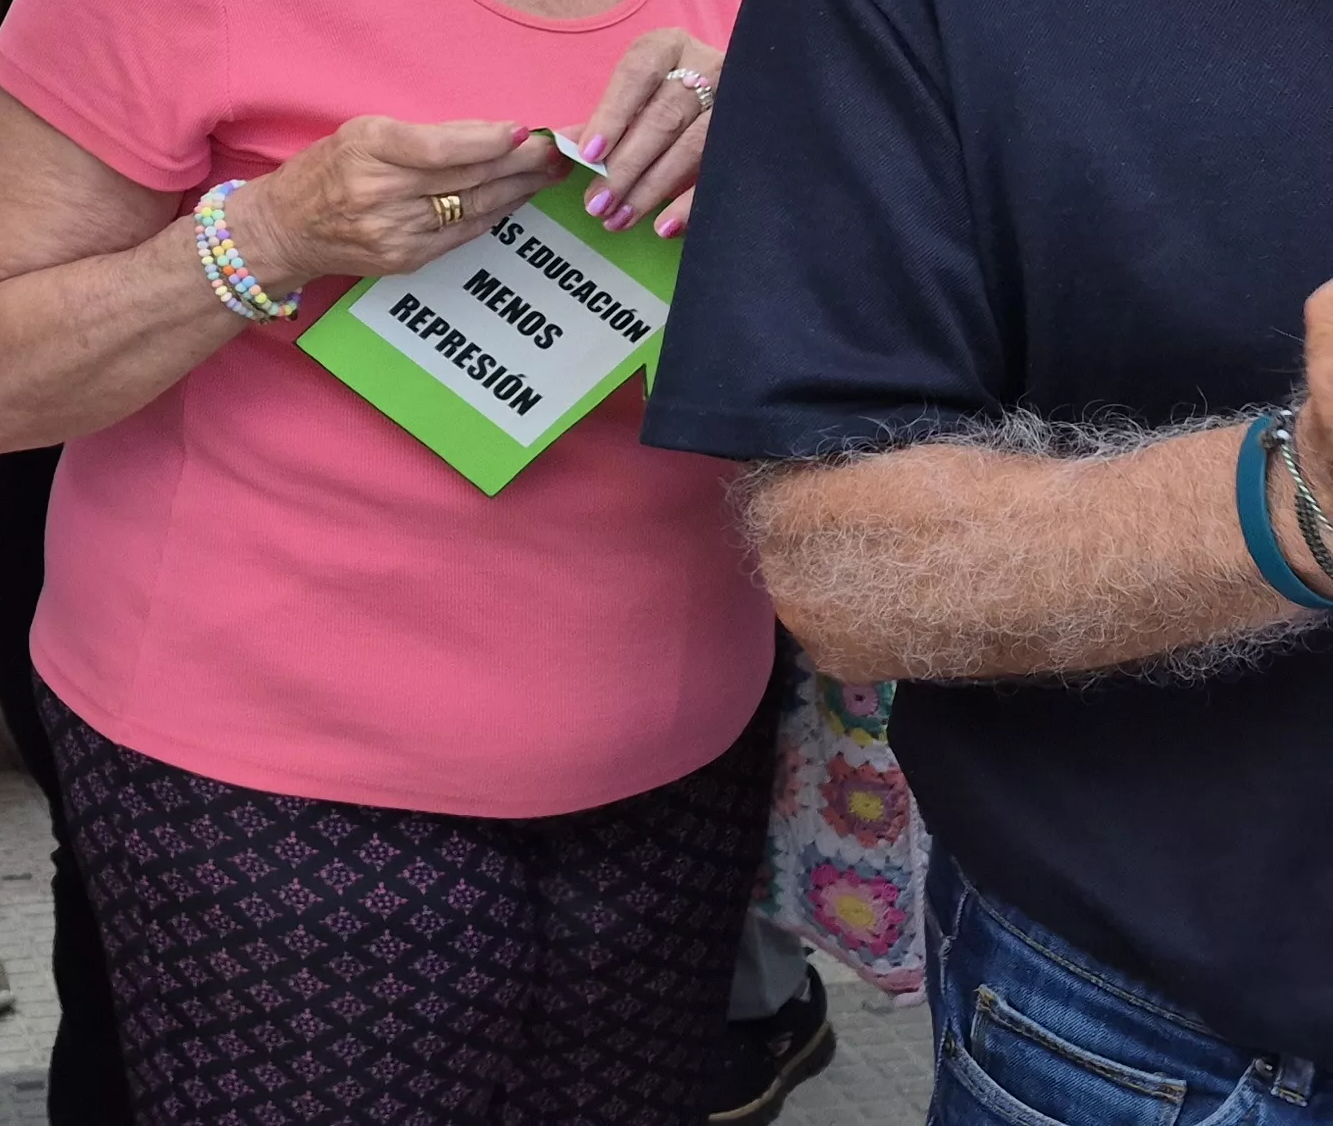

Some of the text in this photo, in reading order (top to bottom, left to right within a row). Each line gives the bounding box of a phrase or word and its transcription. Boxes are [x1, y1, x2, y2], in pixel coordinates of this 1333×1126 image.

[462, 268, 564, 350] MENOS
[515, 236, 652, 344] EDUCACIÓN
[388, 292, 543, 417] REPRESIÓN
